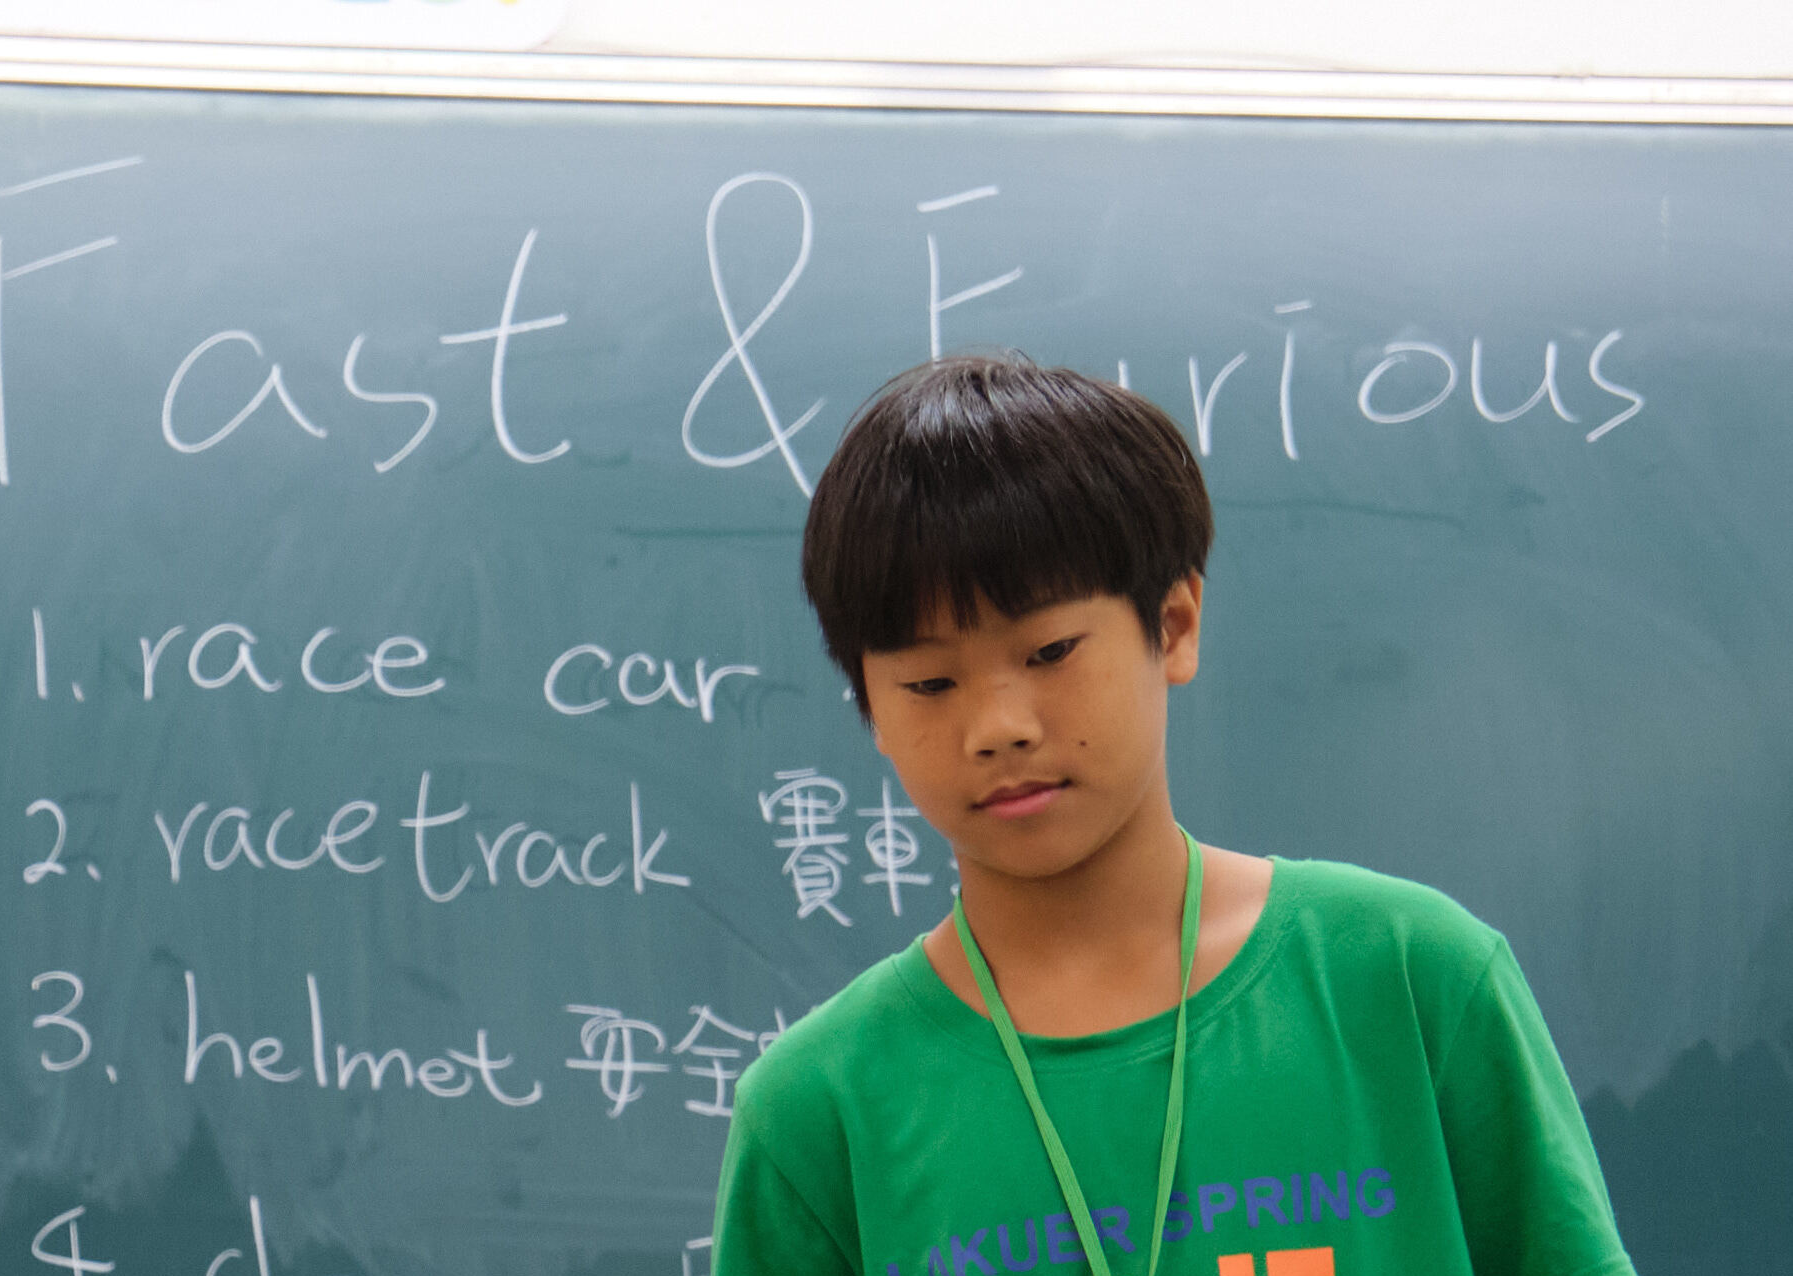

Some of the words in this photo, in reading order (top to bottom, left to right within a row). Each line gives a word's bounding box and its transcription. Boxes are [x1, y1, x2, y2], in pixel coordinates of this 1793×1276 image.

[681, 170, 825, 500] &
[918, 184, 1647, 462] Frious
[35, 608, 85, 702] 1.
[138, 621, 446, 702] race
[543, 642, 761, 722] car
[23, 799, 101, 884] 2.
[30, 970, 119, 1084] 3.
[183, 971, 543, 1107] helmet
[564, 1004, 788, 1119] 安全
[1160, 1167, 1398, 1243] SPRING
